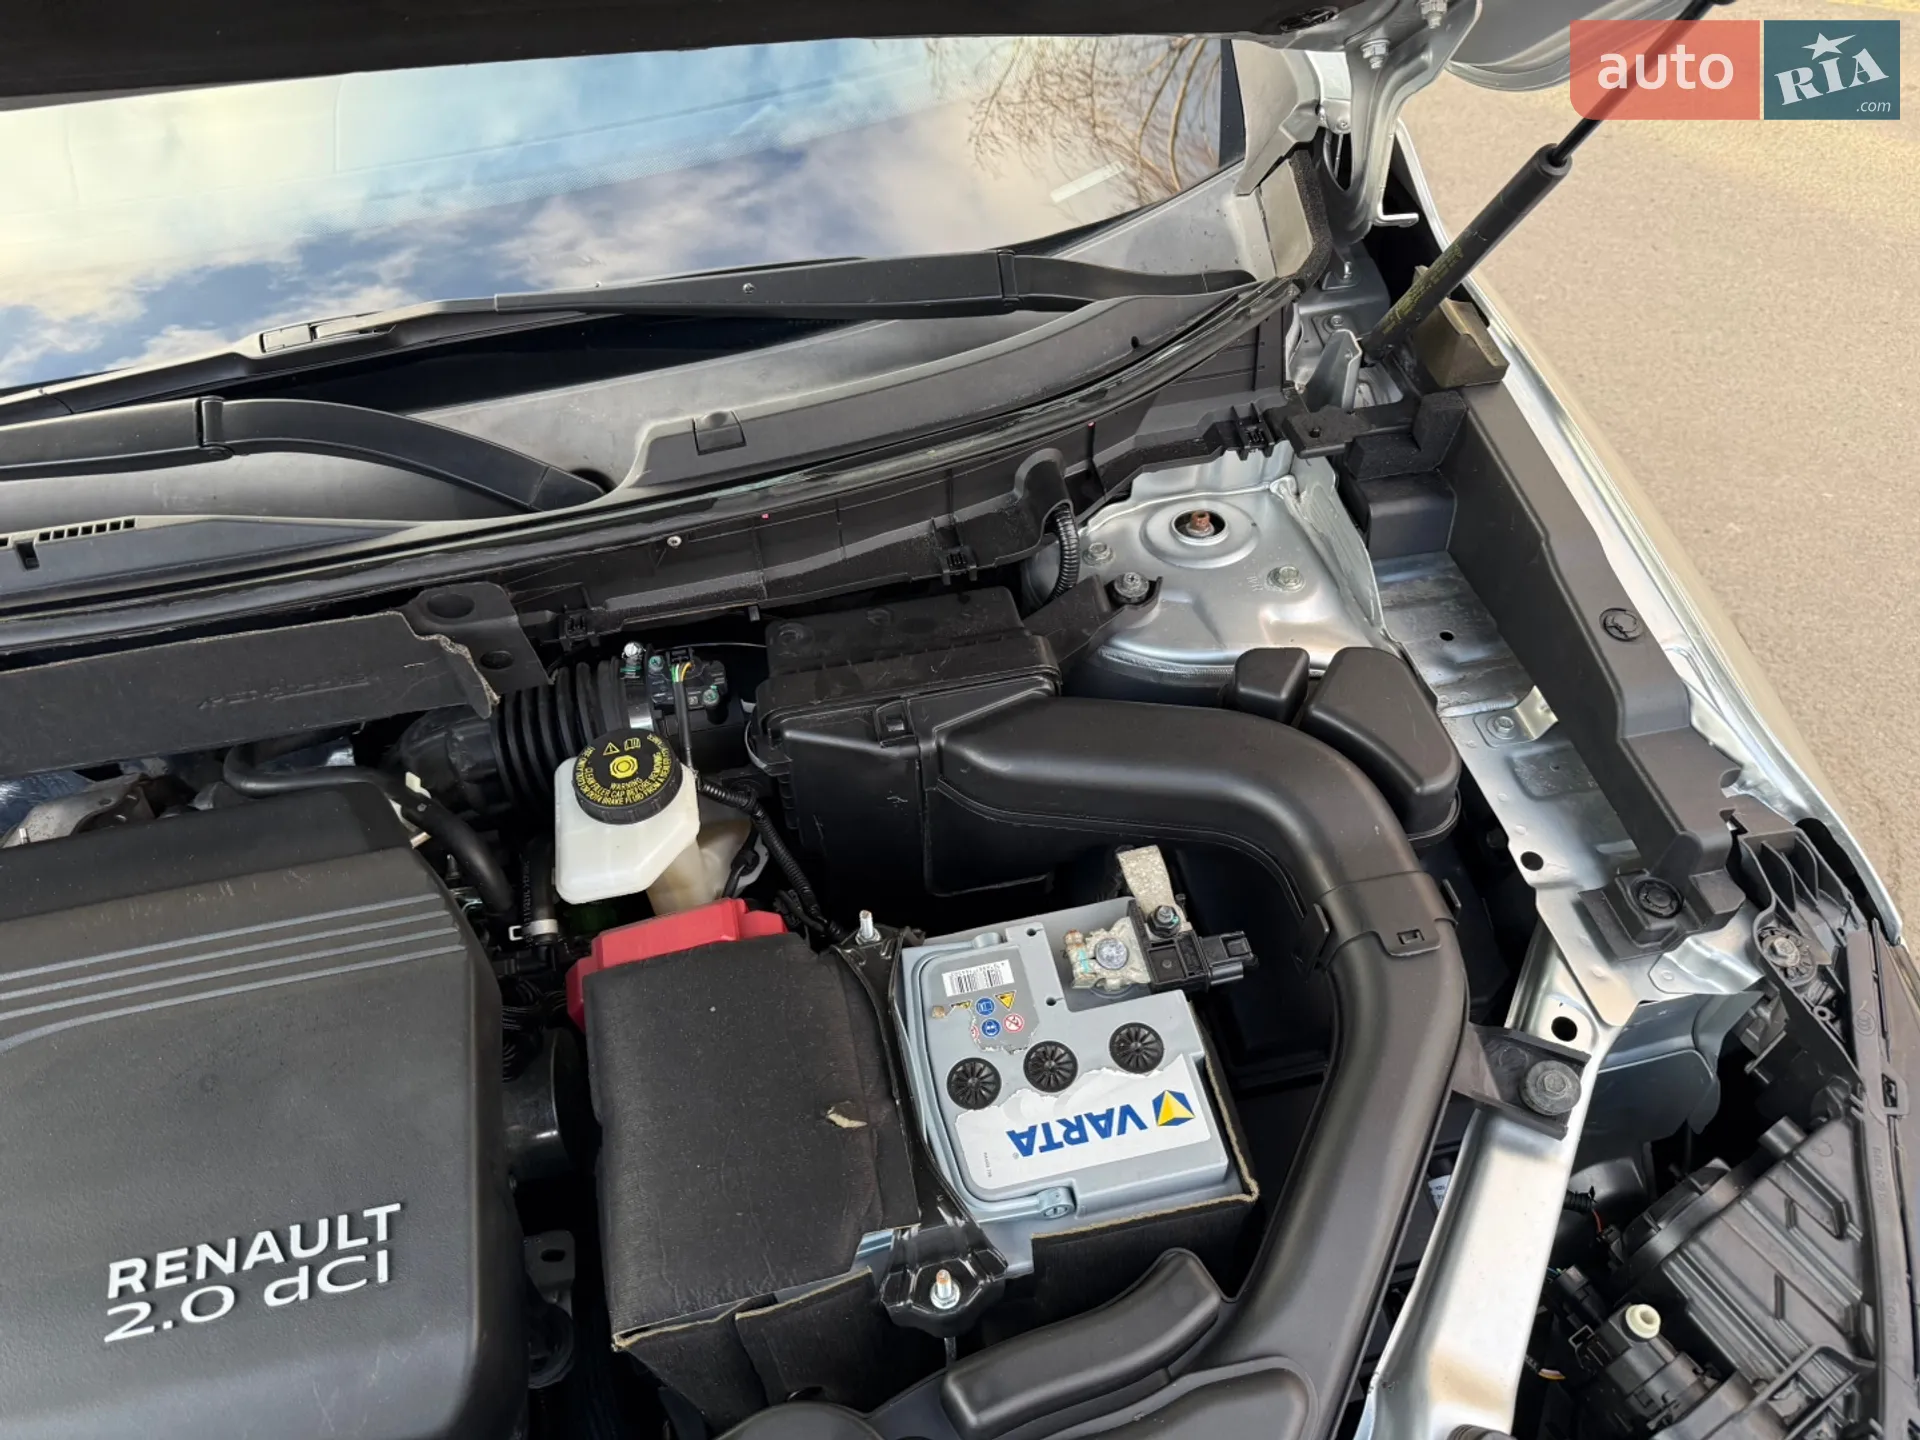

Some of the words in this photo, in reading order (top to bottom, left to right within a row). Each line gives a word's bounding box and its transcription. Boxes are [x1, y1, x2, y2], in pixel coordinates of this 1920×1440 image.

[590, 783, 611, 797] FILLER
[611, 790, 625, 798] CAP
[602, 796, 624, 805] BRAKE
[610, 777, 643, 791] WARNING
[1006, 1104, 1148, 1157] VARTA
[107, 1202, 401, 1299] RENAULT
[104, 1284, 236, 1343] 2.0
